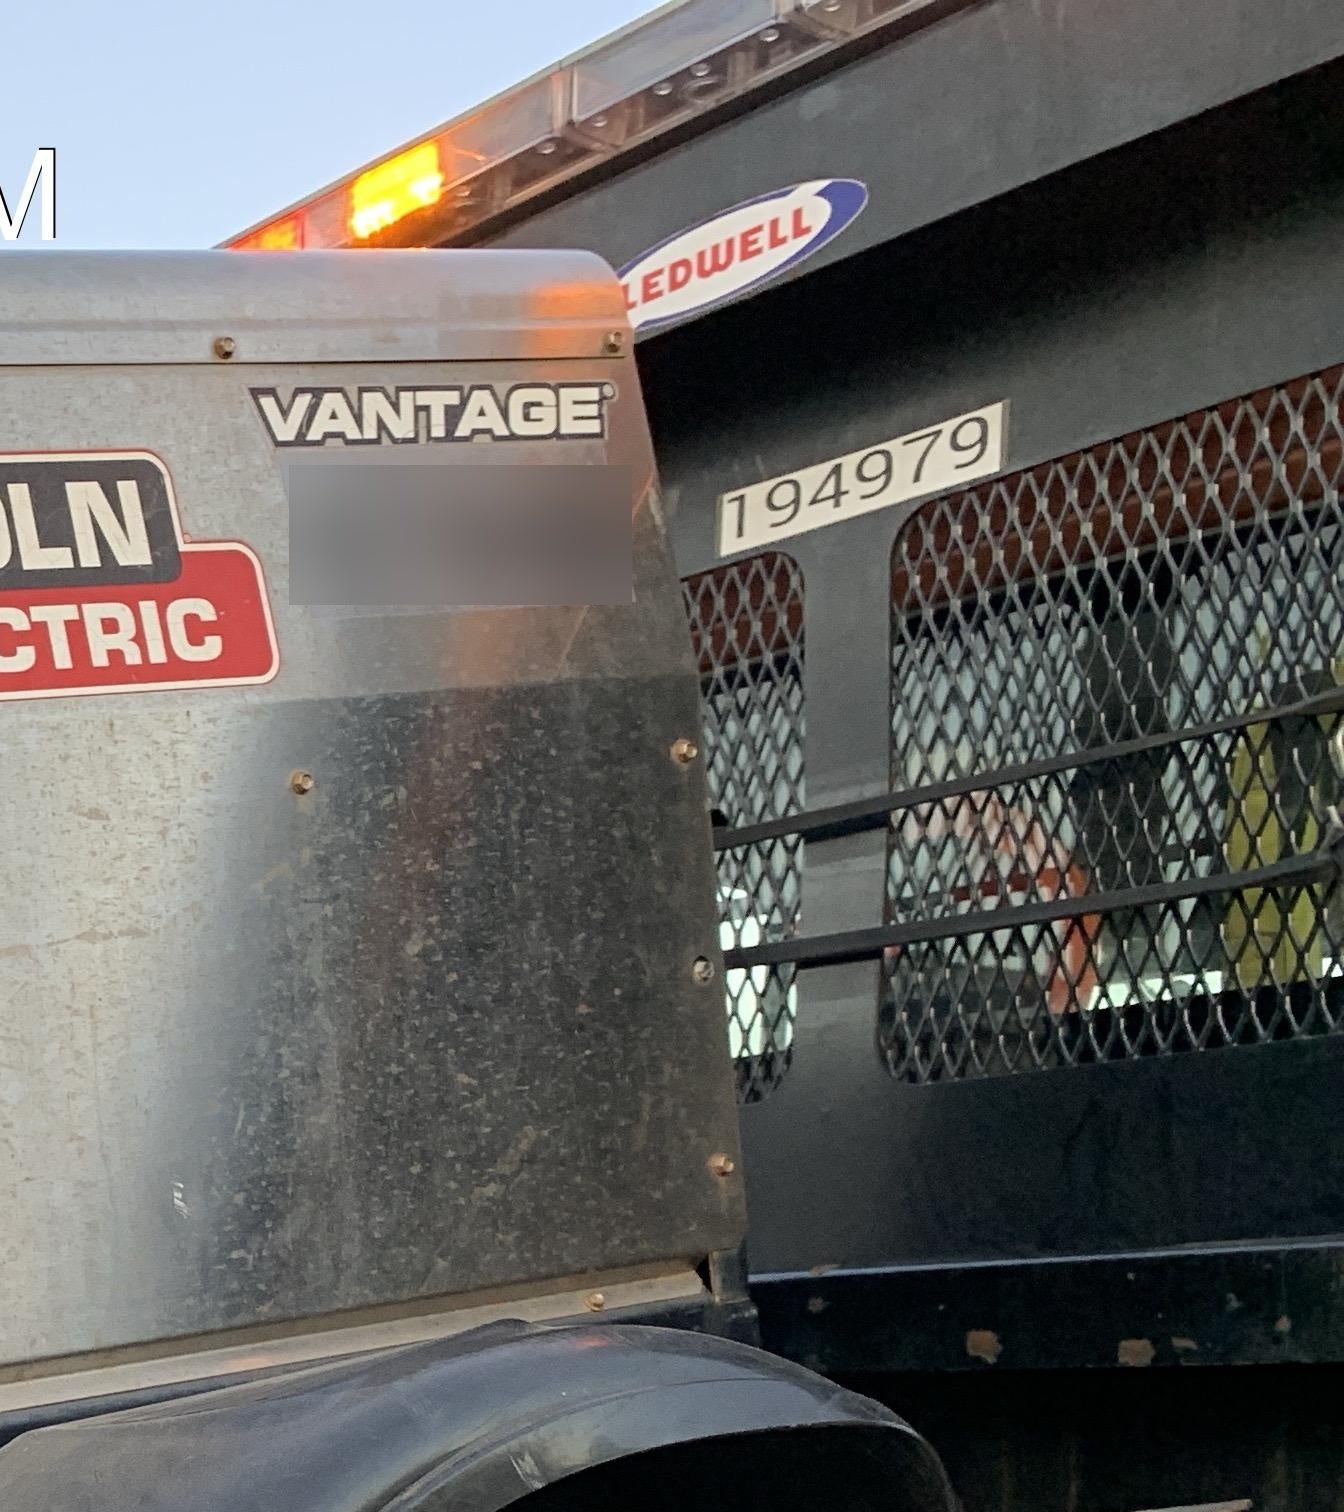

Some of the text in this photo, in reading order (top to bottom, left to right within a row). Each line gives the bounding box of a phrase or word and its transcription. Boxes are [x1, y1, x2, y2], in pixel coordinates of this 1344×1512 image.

[622, 206, 813, 311] LEDWELL
[252, 385, 605, 443] VANTAGE
[726, 415, 989, 538] 194979
